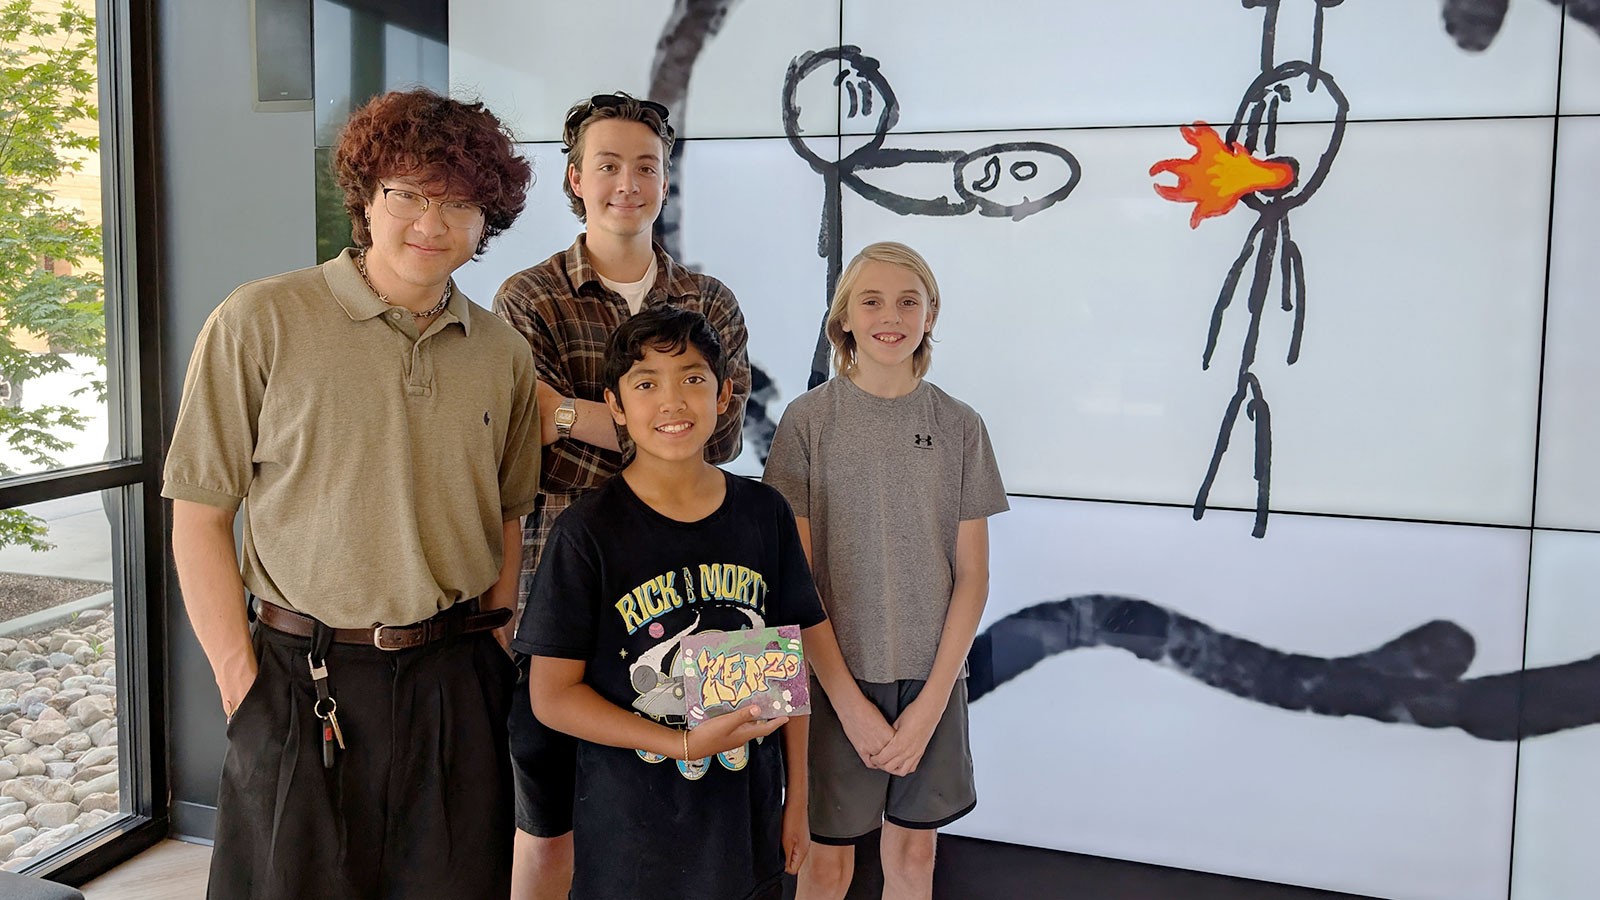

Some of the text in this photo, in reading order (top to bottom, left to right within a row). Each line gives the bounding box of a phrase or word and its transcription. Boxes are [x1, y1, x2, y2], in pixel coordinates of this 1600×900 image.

[615, 570, 683, 635] RICK
[682, 566, 696, 603] AND
[697, 647, 799, 709] KENZO
